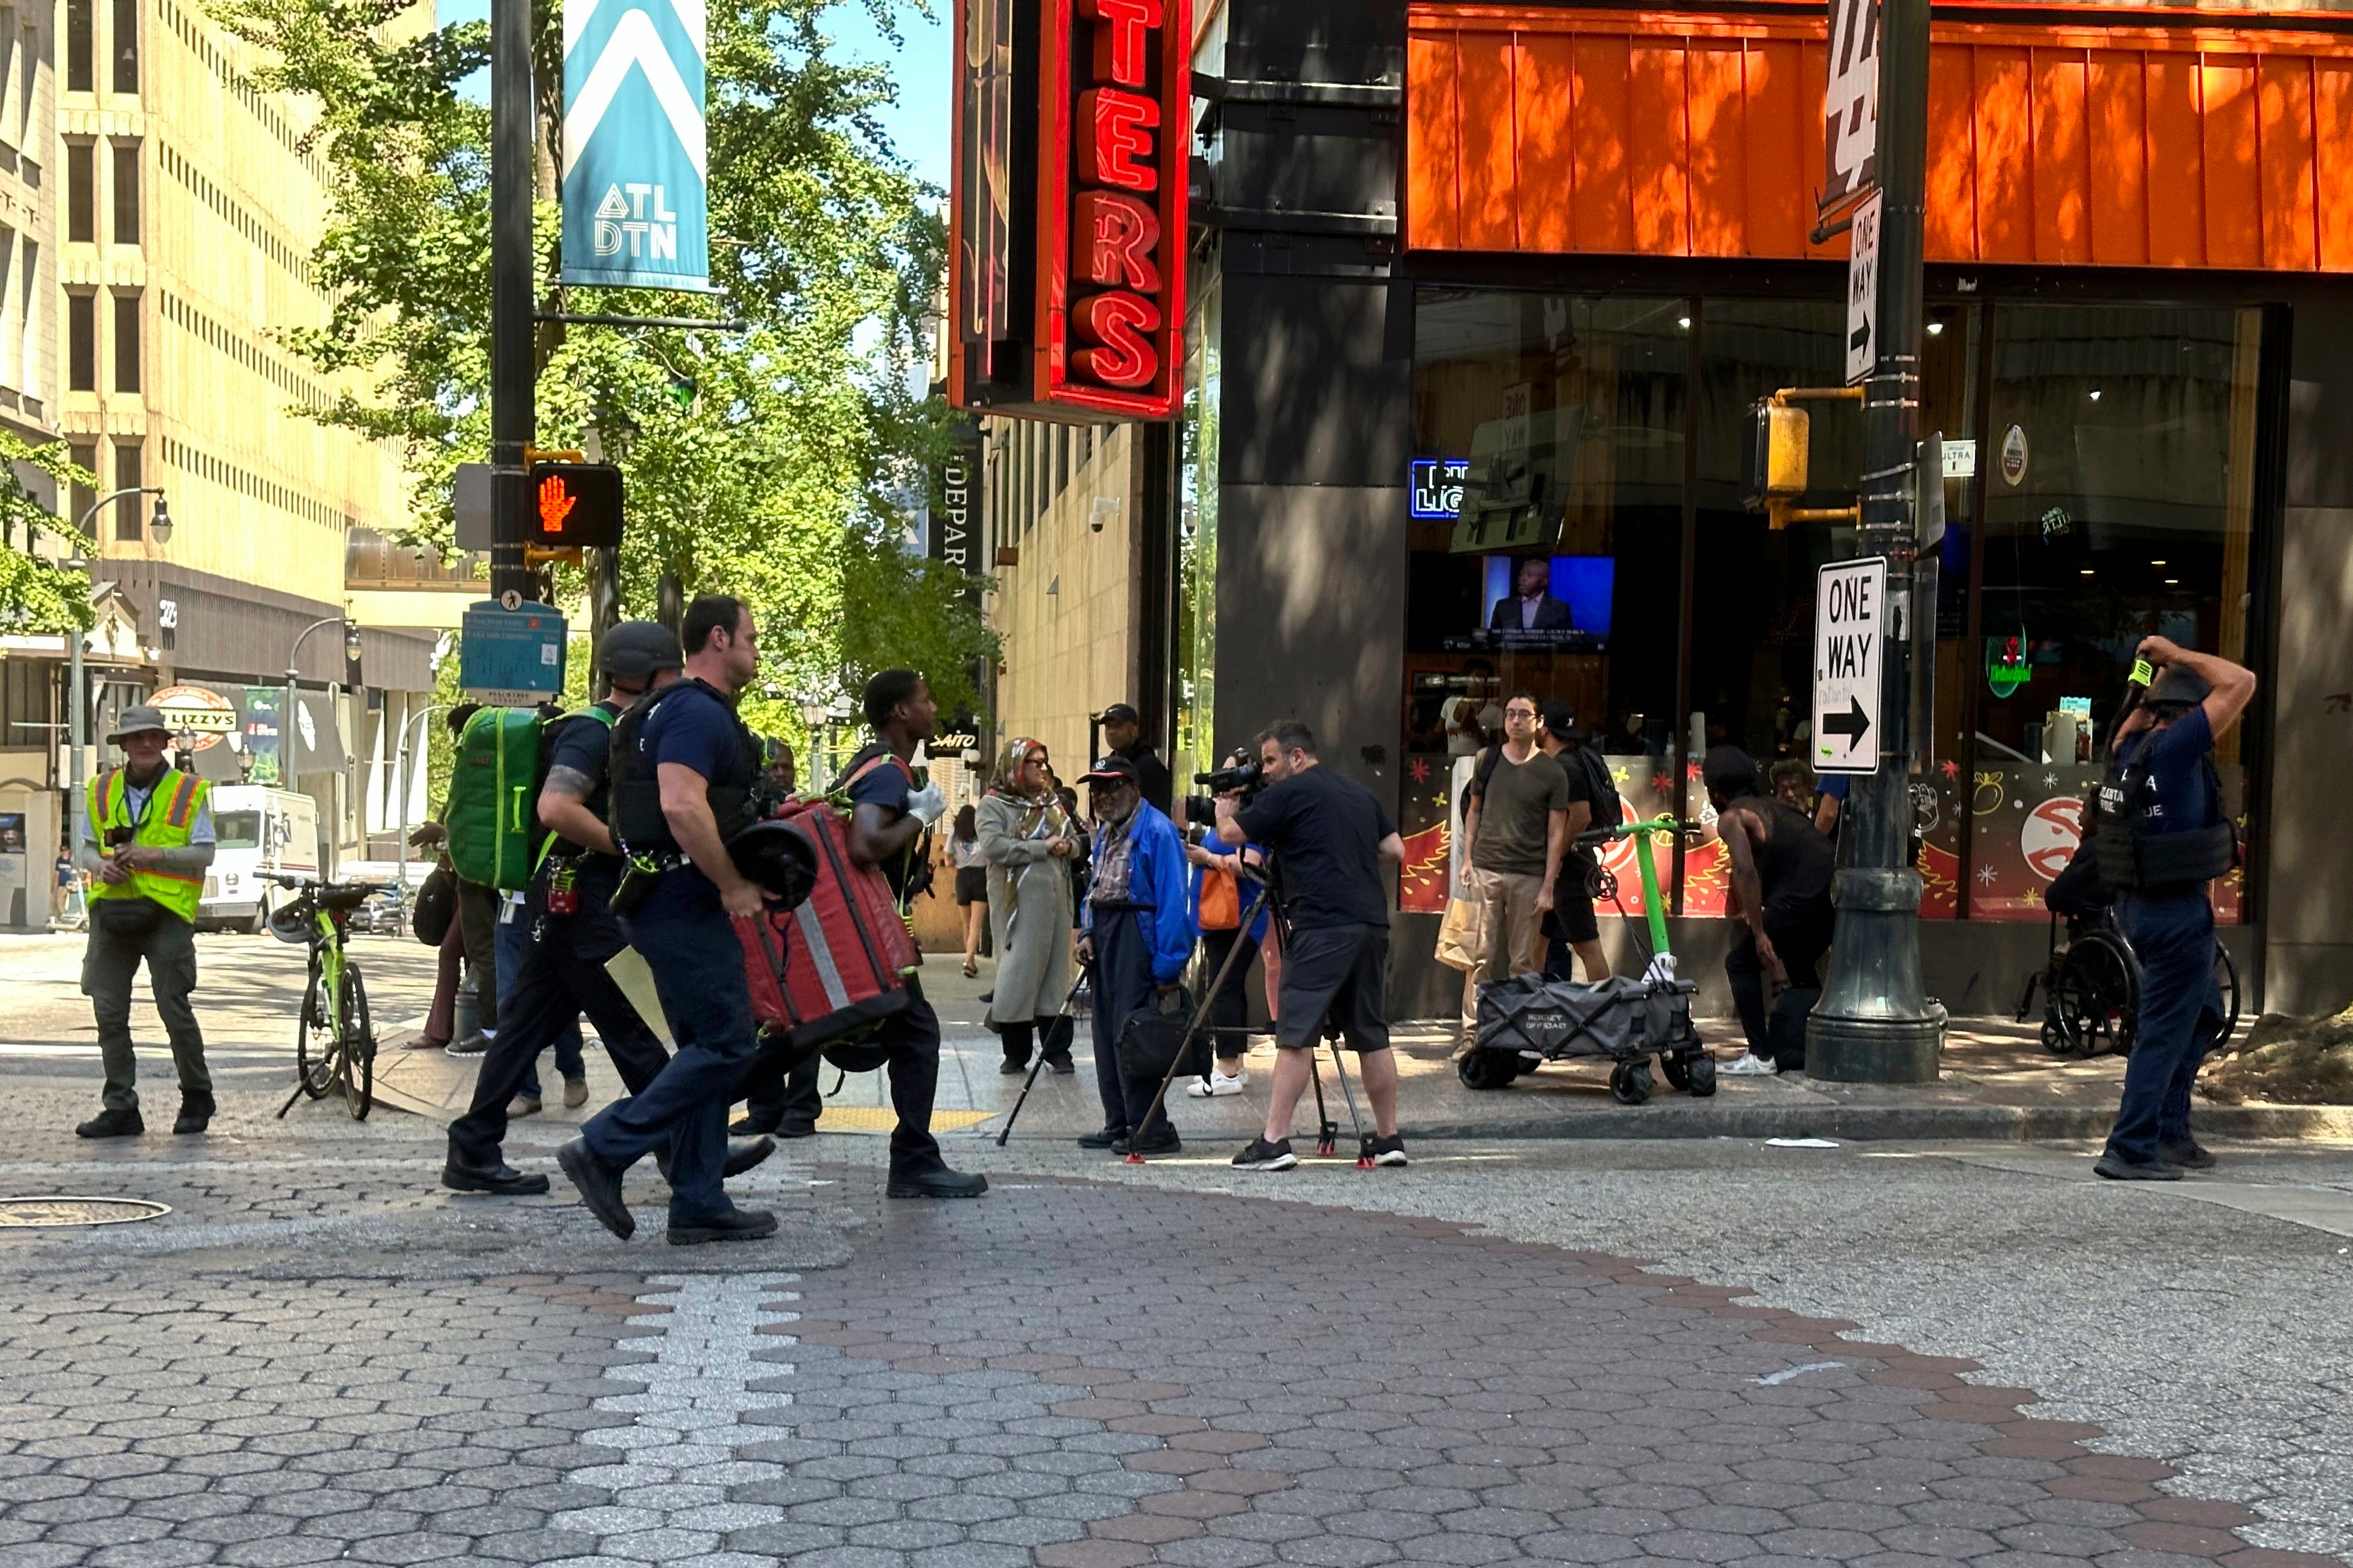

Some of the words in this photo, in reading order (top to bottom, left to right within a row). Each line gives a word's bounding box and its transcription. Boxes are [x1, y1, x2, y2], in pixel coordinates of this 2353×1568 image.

[595, 182, 677, 222] ATL
[594, 220, 677, 260] DTN
[1856, 210, 1875, 259] ONE
[1852, 257, 1873, 307] WAY
[1830, 575, 1872, 623] ONE
[1828, 633, 1872, 679] WAY
[172, 714, 234, 725] LIZZY'S
